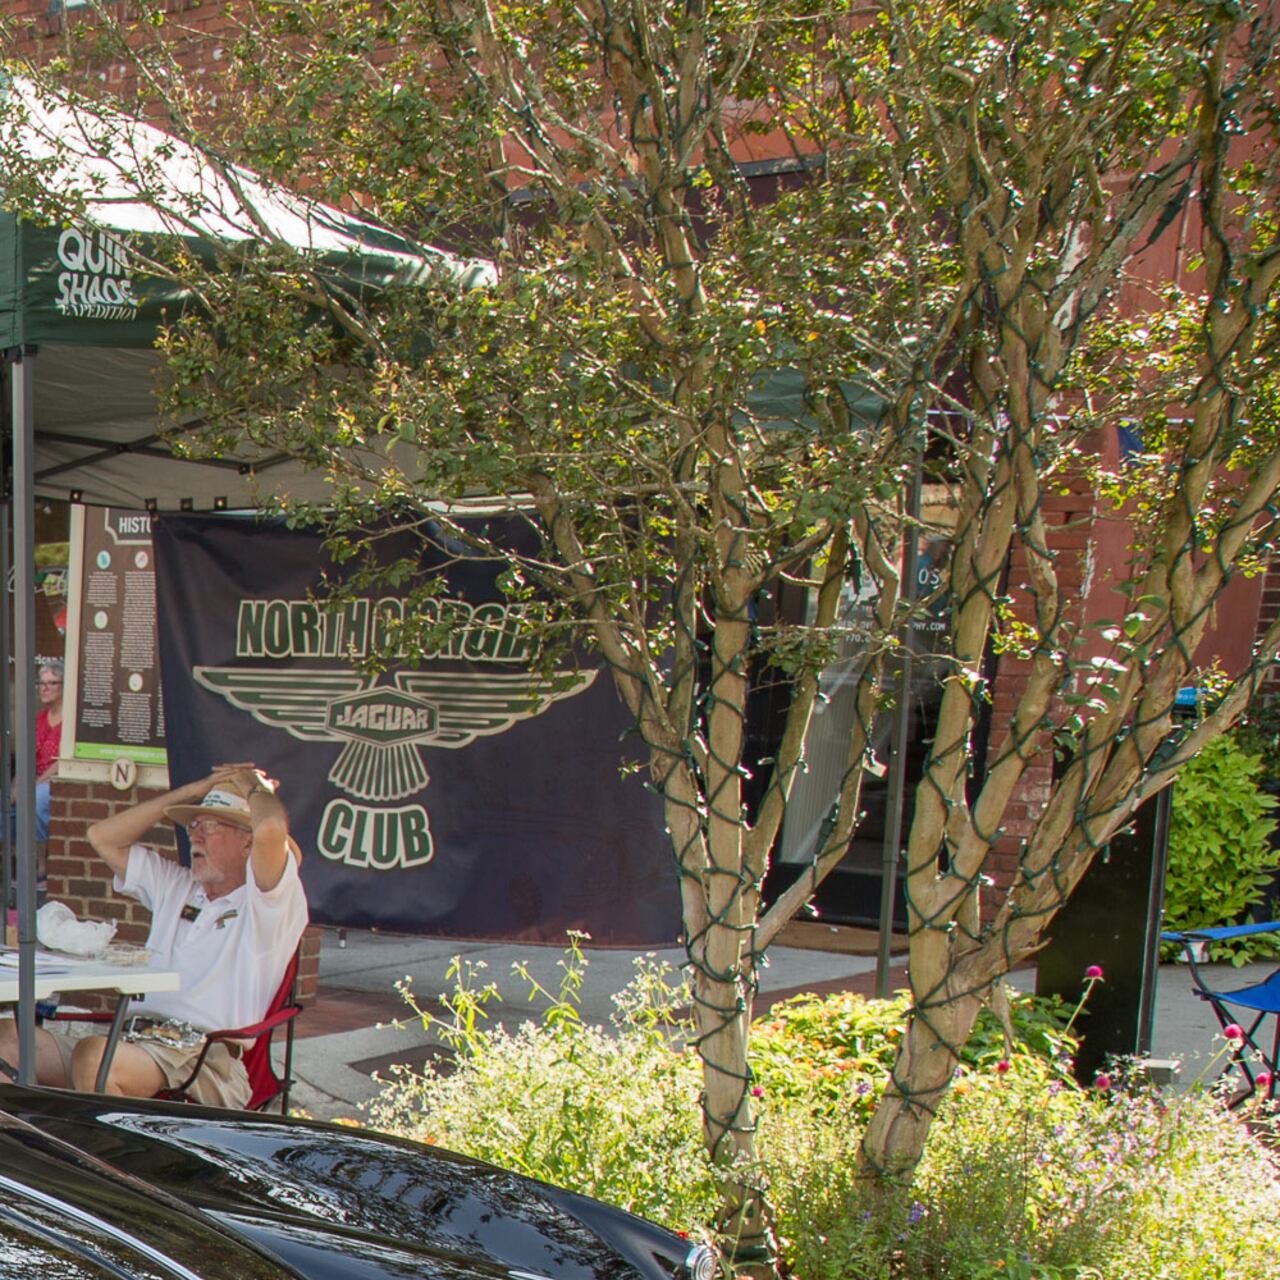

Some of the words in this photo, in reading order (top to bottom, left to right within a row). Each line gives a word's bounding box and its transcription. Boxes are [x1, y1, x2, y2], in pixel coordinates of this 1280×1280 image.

[236, 597, 370, 658] NORTH
[335, 703, 430, 732] JAGUAR
[115, 763, 130, 784] N
[316, 798, 434, 871] CLUB
